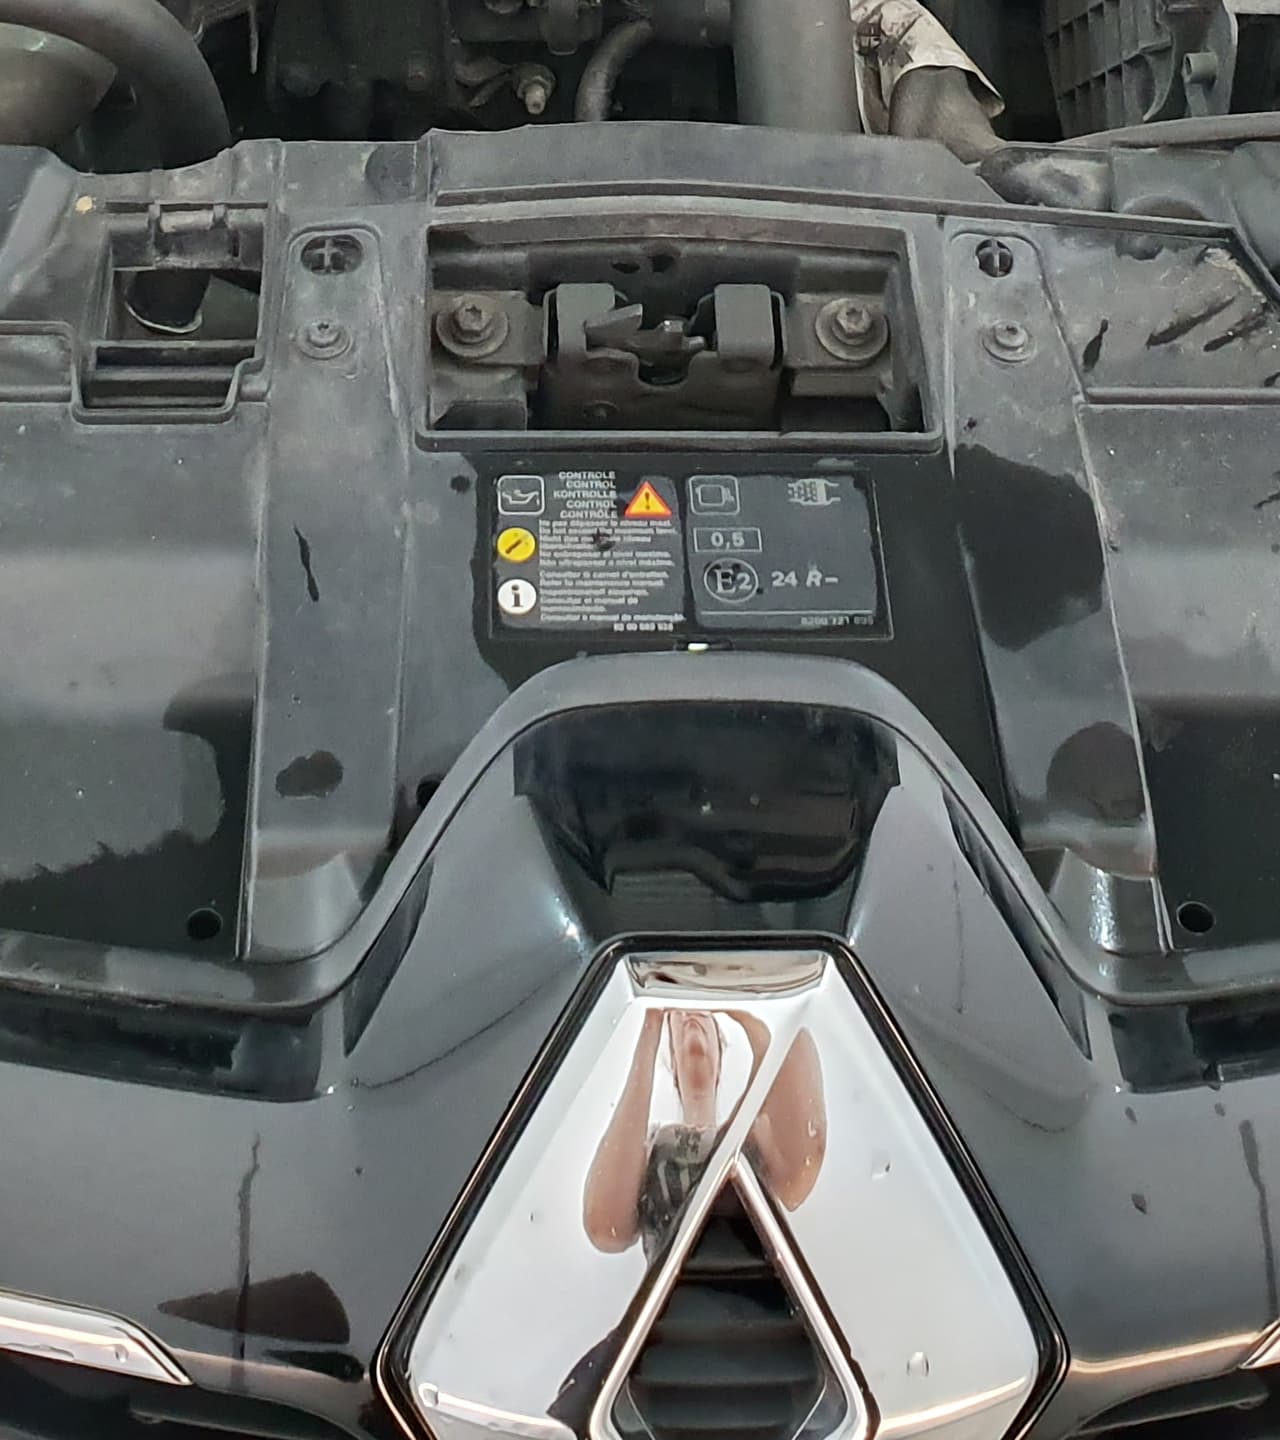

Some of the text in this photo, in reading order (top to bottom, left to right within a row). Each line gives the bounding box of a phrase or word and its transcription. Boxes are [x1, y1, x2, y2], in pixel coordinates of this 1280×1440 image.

[558, 471, 616, 480] CONTROLE
[566, 480, 617, 489] CONTROL
[553, 490, 617, 499] KONTROLLE
[566, 499, 617, 509] CONTROL
[710, 531, 745, 550] 0,5
[771, 571, 798, 587] 24
